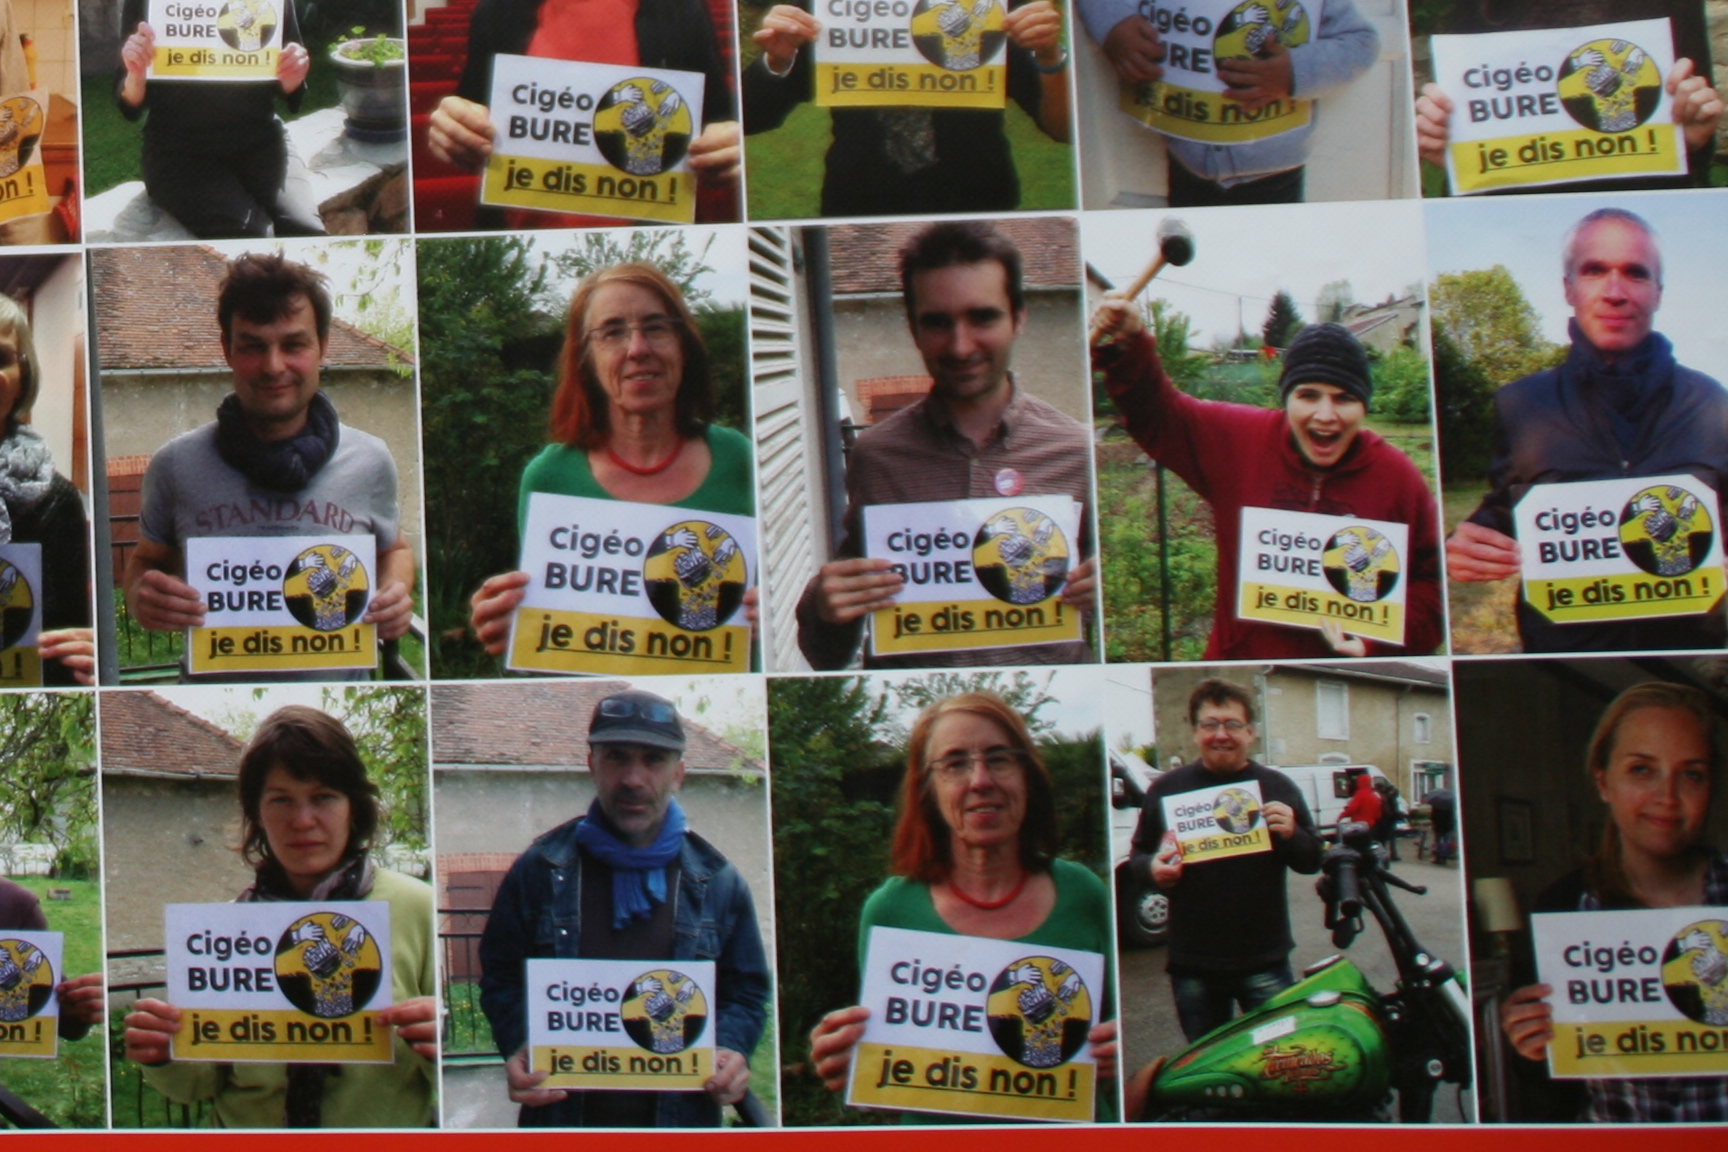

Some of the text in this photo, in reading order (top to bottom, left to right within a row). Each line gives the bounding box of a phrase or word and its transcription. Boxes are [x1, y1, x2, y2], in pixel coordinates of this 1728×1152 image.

[166, 3, 216, 21] Cigéo
[166, 24, 215, 37] BURE
[828, 28, 909, 48] BURE
[166, 49, 184, 66] je
[190, 50, 216, 64] dis
[225, 51, 258, 65] non
[831, 67, 857, 93] je
[868, 65, 909, 89] dis
[921, 70, 976, 90] non
[196, 499, 355, 534] STANDARD
[1536, 507, 1615, 535] Cigéo
[550, 525, 644, 559] Cigéo
[1539, 537, 1620, 563] BURE
[207, 560, 282, 586] Cigéo
[545, 562, 641, 596] BURE
[207, 591, 283, 612] BURE
[1547, 582, 1574, 610] je
[1582, 579, 1624, 604] dis
[1634, 578, 1690, 599] non
[209, 631, 235, 658] je
[243, 630, 283, 652] dis
[292, 634, 344, 654] non
[187, 930, 272, 961] Cigéo
[188, 968, 273, 992] BURE
[891, 959, 986, 994] Cigéo
[191, 1014, 220, 1044] je
[230, 1013, 276, 1041] dis
[287, 1019, 351, 1042] non
[885, 997, 984, 1032] BURE
[877, 1050, 913, 1087] je
[926, 1054, 977, 1088] dis
[991, 1068, 1056, 1095] non
